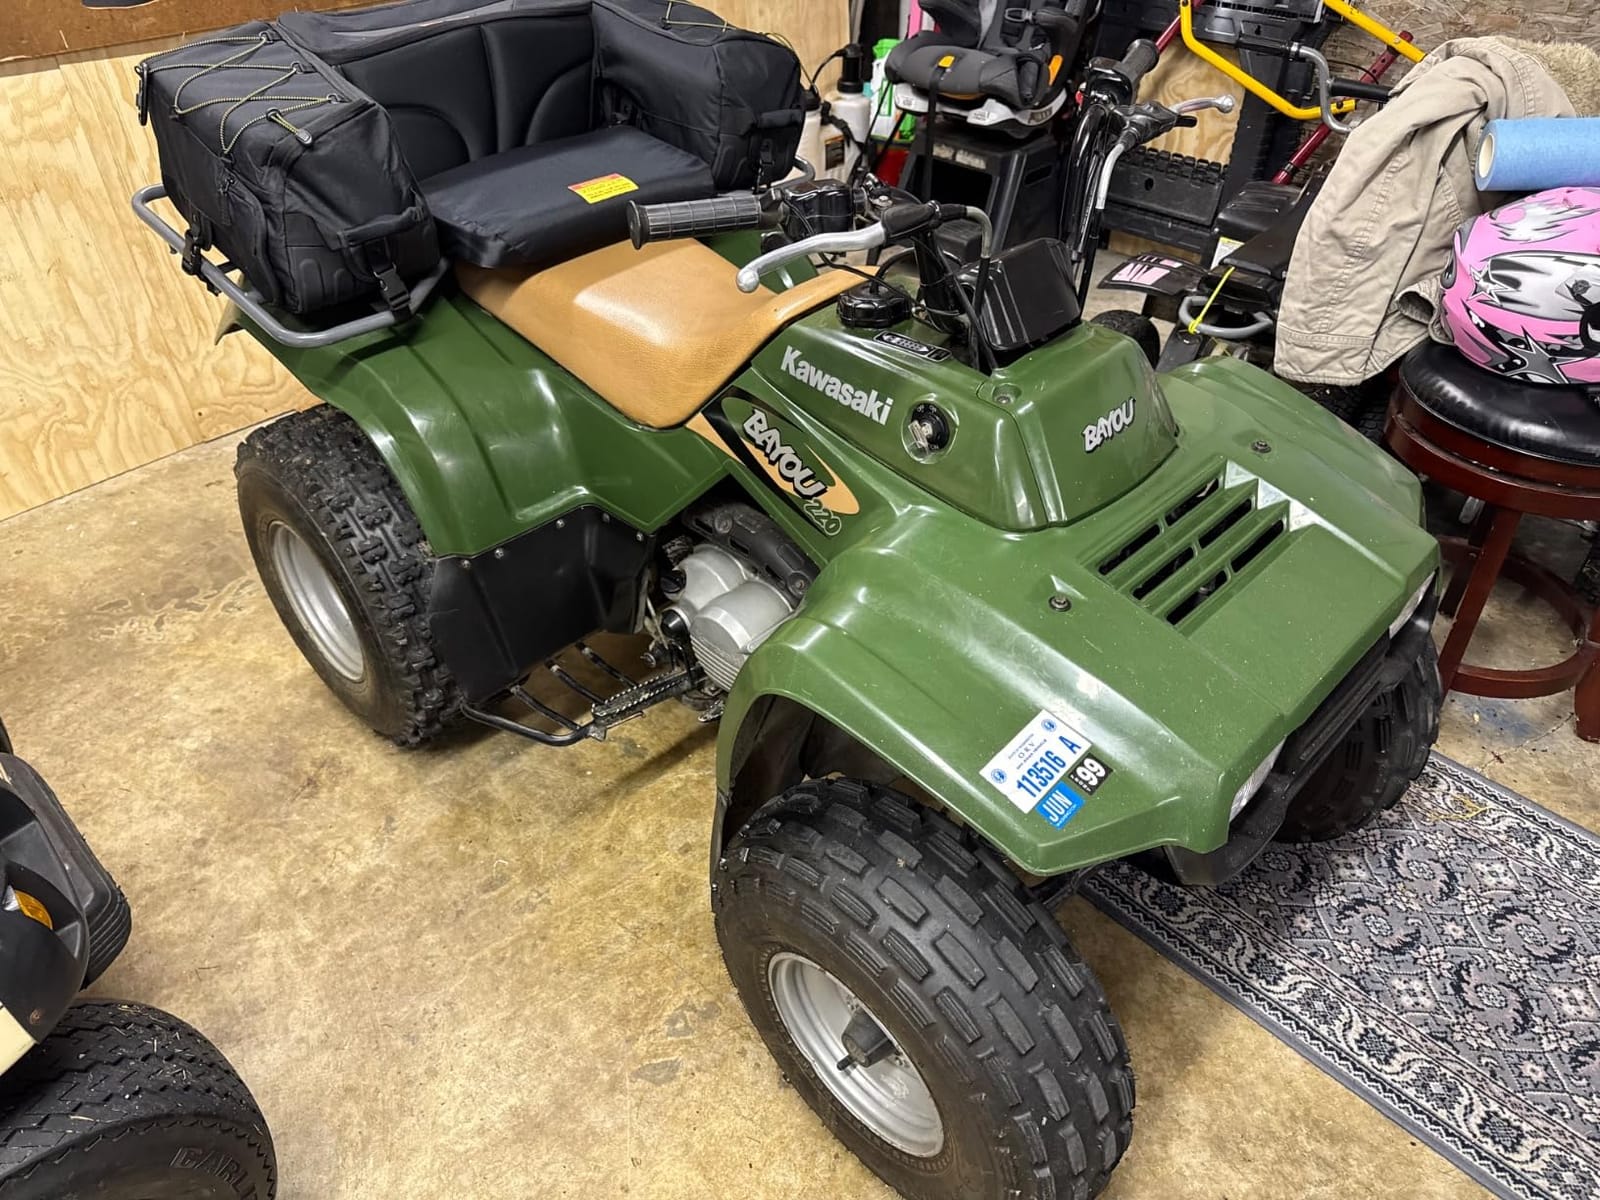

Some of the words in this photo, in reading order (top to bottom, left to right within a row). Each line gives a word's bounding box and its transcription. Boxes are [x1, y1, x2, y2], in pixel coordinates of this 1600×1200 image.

[780, 344, 894, 427] Kawasaki
[742, 407, 829, 500] BAYOU
[1081, 396, 1136, 454] BAYOU
[802, 499, 842, 536] 220
[1015, 749, 1067, 799] 113516
[1057, 734, 1082, 755] A
[1075, 756, 1106, 787] 99
[1041, 788, 1074, 824] JUN
